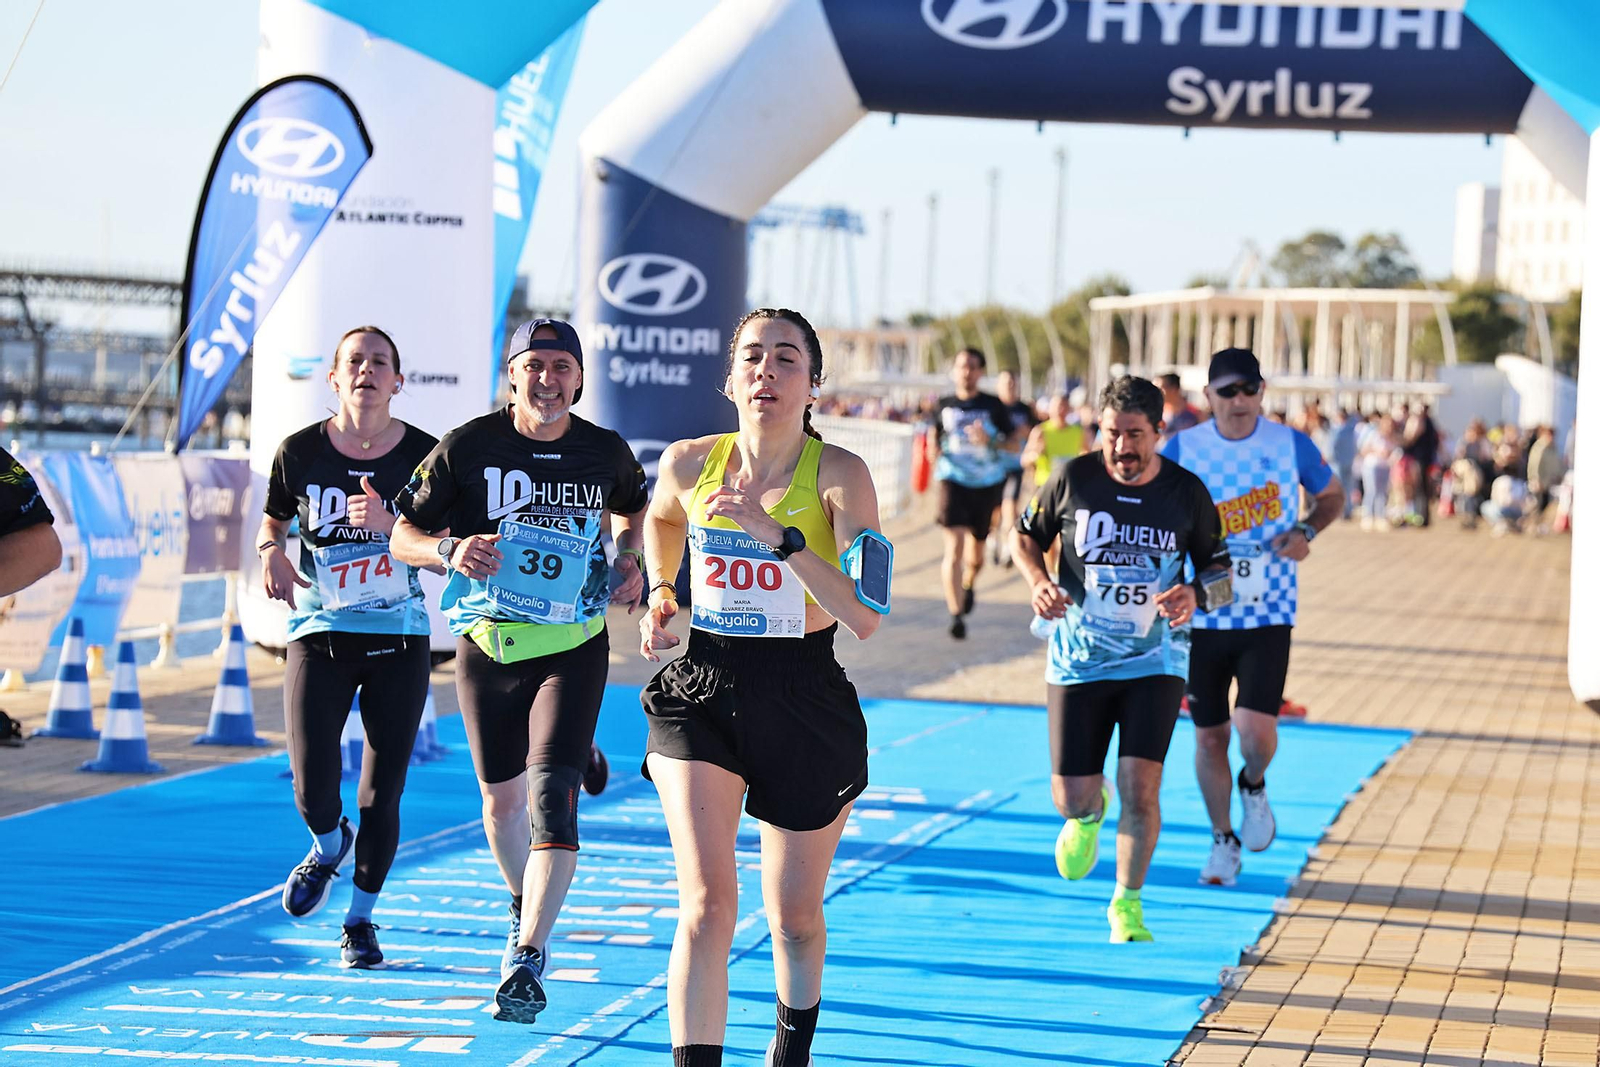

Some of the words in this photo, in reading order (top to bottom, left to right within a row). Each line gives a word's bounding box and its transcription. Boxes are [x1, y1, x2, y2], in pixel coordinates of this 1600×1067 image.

[1086, 0, 1463, 50] HYUNDAI
[1165, 65, 1374, 122] Syrluz
[229, 170, 340, 209] HYUNDAI
[189, 219, 302, 380] Syrluz
[585, 321, 722, 355] HYUNDAI
[608, 355, 693, 387] Syrluz
[530, 505, 551, 514] PUERTA
[551, 507, 561, 515] DEL
[531, 481, 604, 510] HUELVA
[1216, 480, 1281, 517] panish
[518, 529, 539, 541] HUELVA
[540, 535, 570, 549] AVATEL
[706, 535, 733, 546] HUELVA
[1112, 523, 1177, 551] HUELVA
[330, 553, 393, 590] 774
[518, 549, 563, 581] 39
[704, 556, 783, 591] 200
[1237, 560, 1251, 578] 8
[501, 589, 545, 610] Wayalia
[1097, 584, 1148, 606] 765
[707, 610, 759, 628] Wayalia
[29, 1022, 310, 1041] HUELVA
